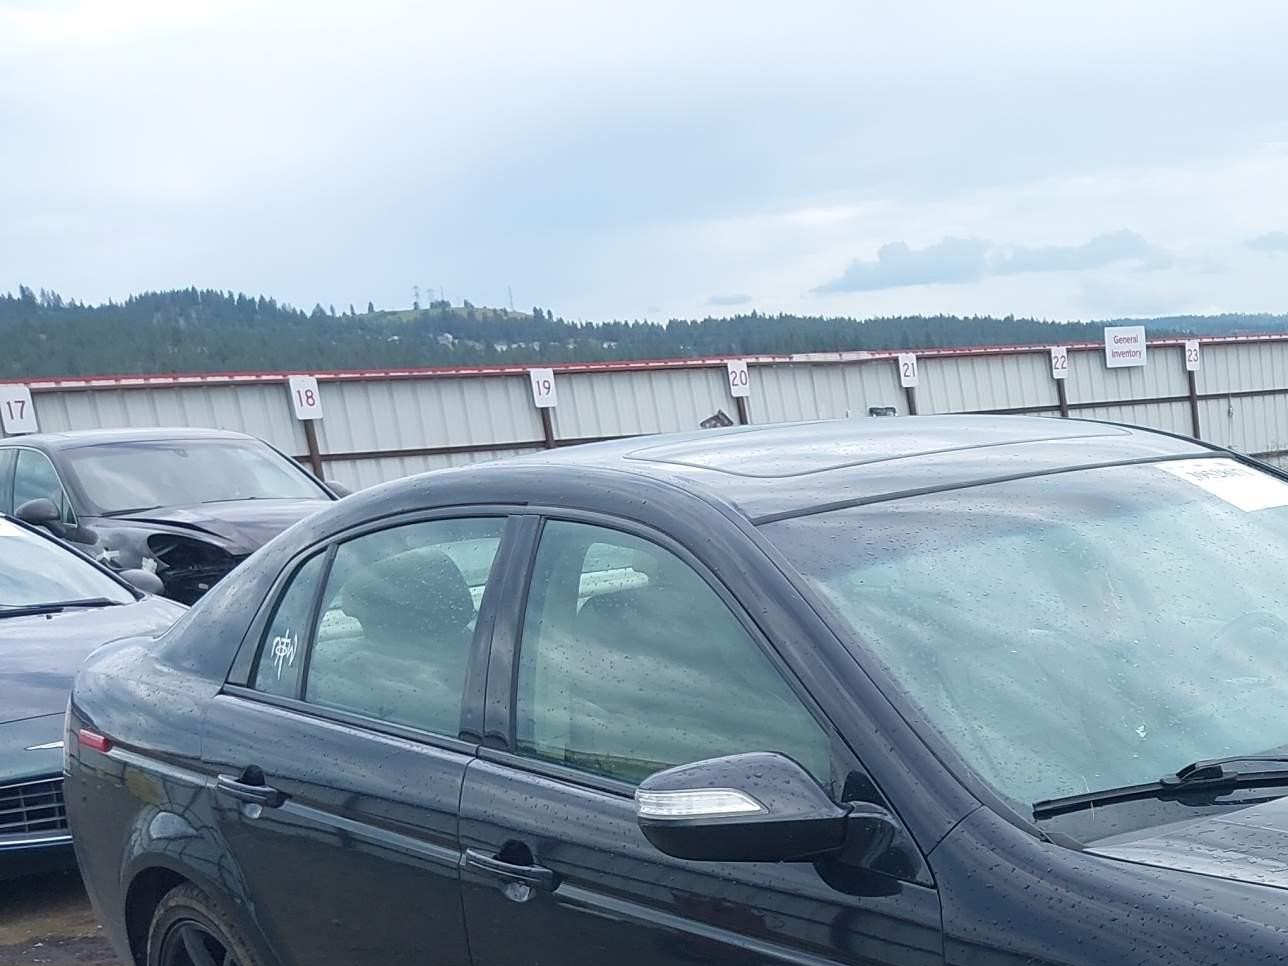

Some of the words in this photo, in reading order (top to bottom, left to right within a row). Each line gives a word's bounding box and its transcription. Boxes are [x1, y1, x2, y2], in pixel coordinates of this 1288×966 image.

[1113, 334, 1139, 345] General
[1111, 349, 1142, 359] Inventory
[1187, 348, 1199, 362] 23
[903, 362, 916, 377] 21
[1053, 355, 1067, 370] 22
[730, 369, 748, 386] 20
[536, 379, 551, 396] 19
[296, 389, 316, 407] 18
[6, 400, 26, 420] 17
